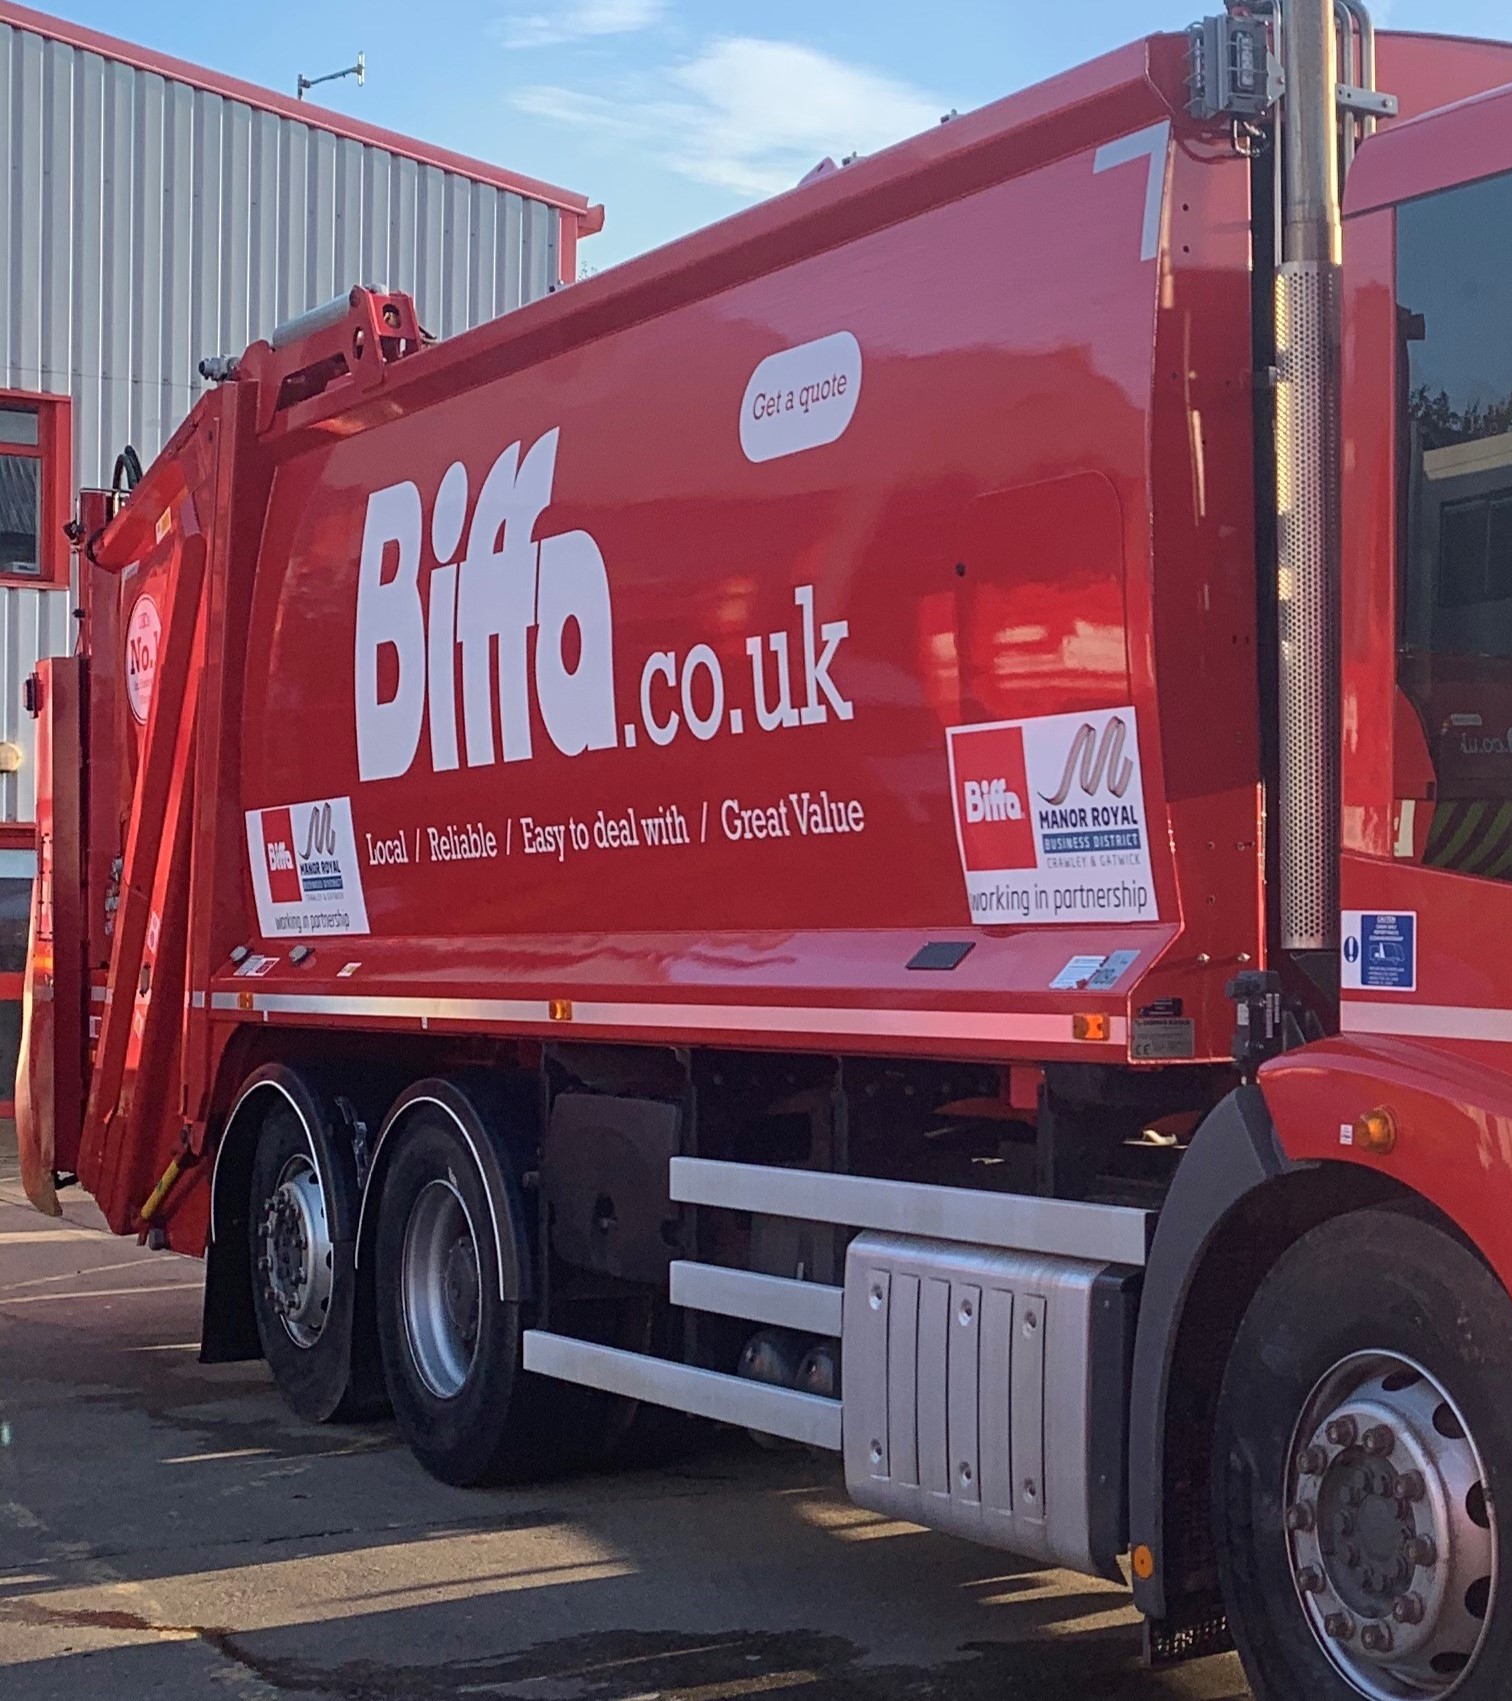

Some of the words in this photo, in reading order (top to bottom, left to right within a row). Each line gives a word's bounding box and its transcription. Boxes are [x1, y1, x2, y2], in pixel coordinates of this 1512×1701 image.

[753, 389, 781, 421] Get
[785, 390, 794, 411] a
[799, 373, 847, 414] quote
[964, 778, 1024, 824] Biffa
[1039, 807, 1088, 830] MANOR
[1091, 804, 1138, 827] ROYAL
[366, 830, 409, 866] Local
[427, 822, 498, 862] Reliable
[520, 816, 566, 863] Easy
[569, 816, 590, 851] to
[594, 810, 640, 849] deal
[641, 804, 690, 847] with
[721, 798, 791, 841] Great
[788, 790, 865, 836] Value
[1043, 834, 1091, 851] BUSINESS
[1093, 832, 1139, 849] DISTRICT
[970, 884, 1030, 917] working
[1034, 883, 1049, 910] in
[1054, 879, 1148, 914] partnership
